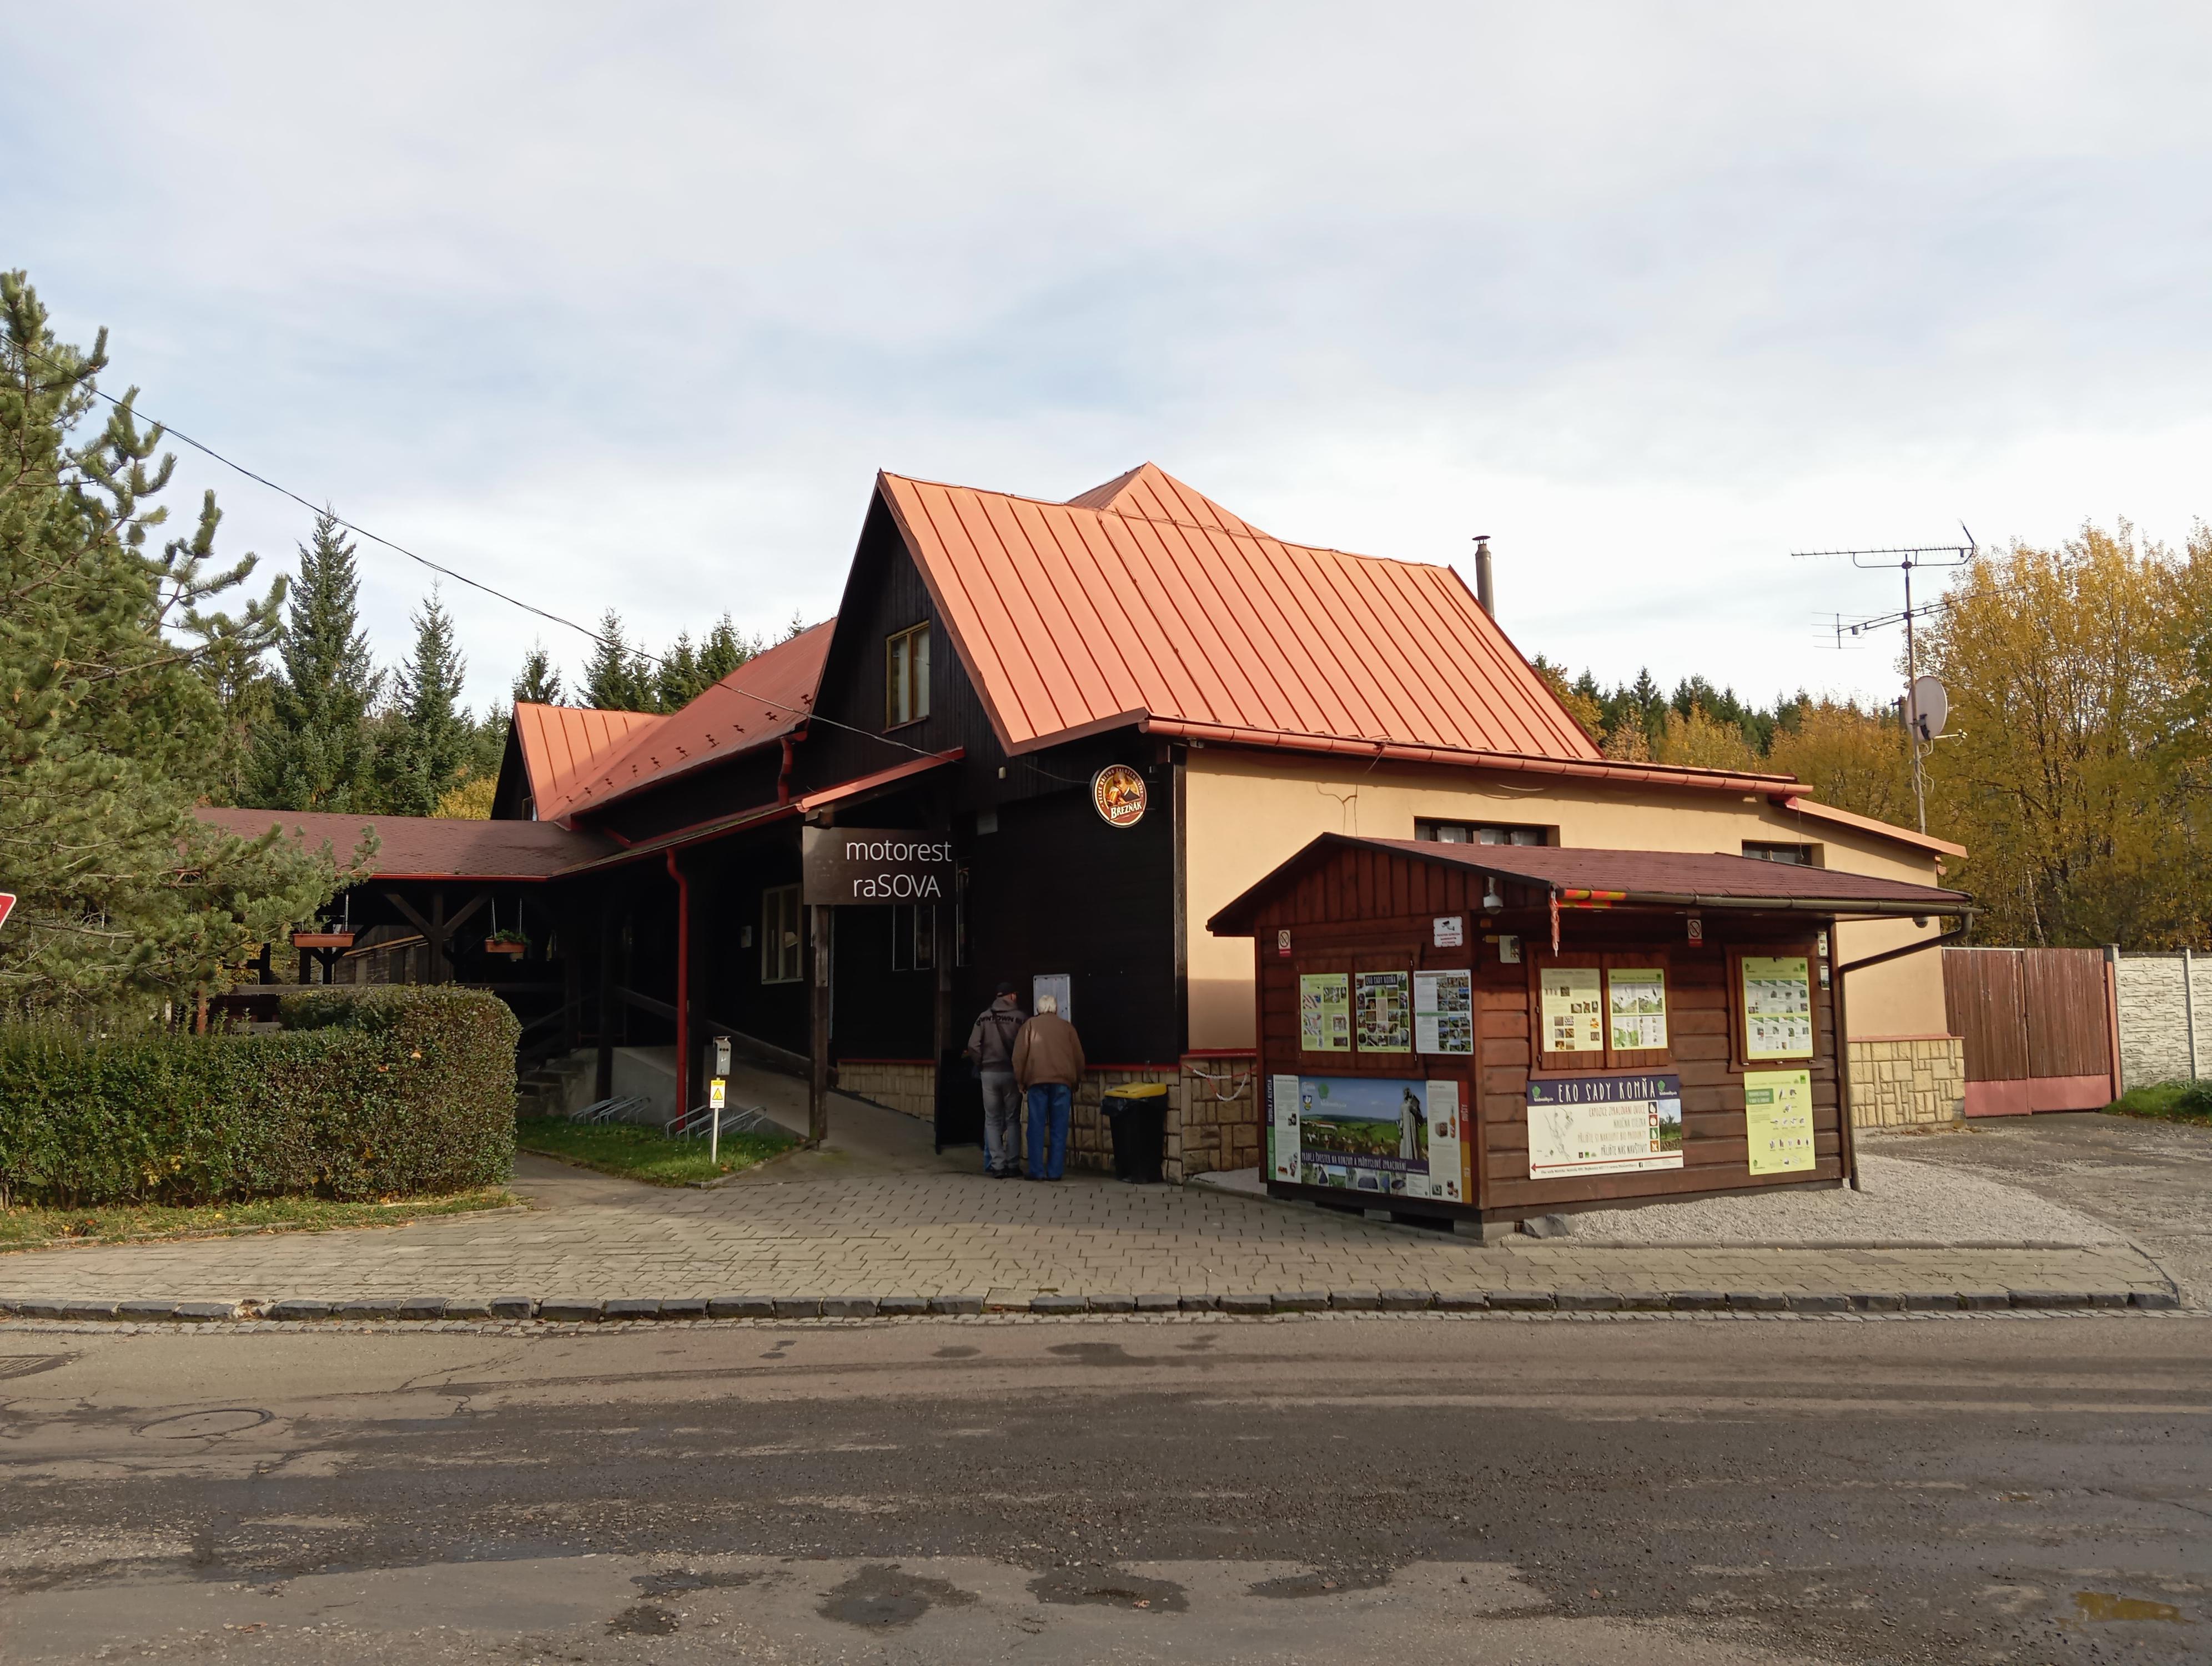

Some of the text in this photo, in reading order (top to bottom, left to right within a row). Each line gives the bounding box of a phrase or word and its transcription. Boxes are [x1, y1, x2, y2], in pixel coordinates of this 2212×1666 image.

[1110, 801, 1143, 819] BŘEZŇÁK
[846, 840, 952, 862] motorest
[853, 874, 941, 898] raSOVA
[1558, 1077, 1656, 1103] EKO SADY KOMŇA
